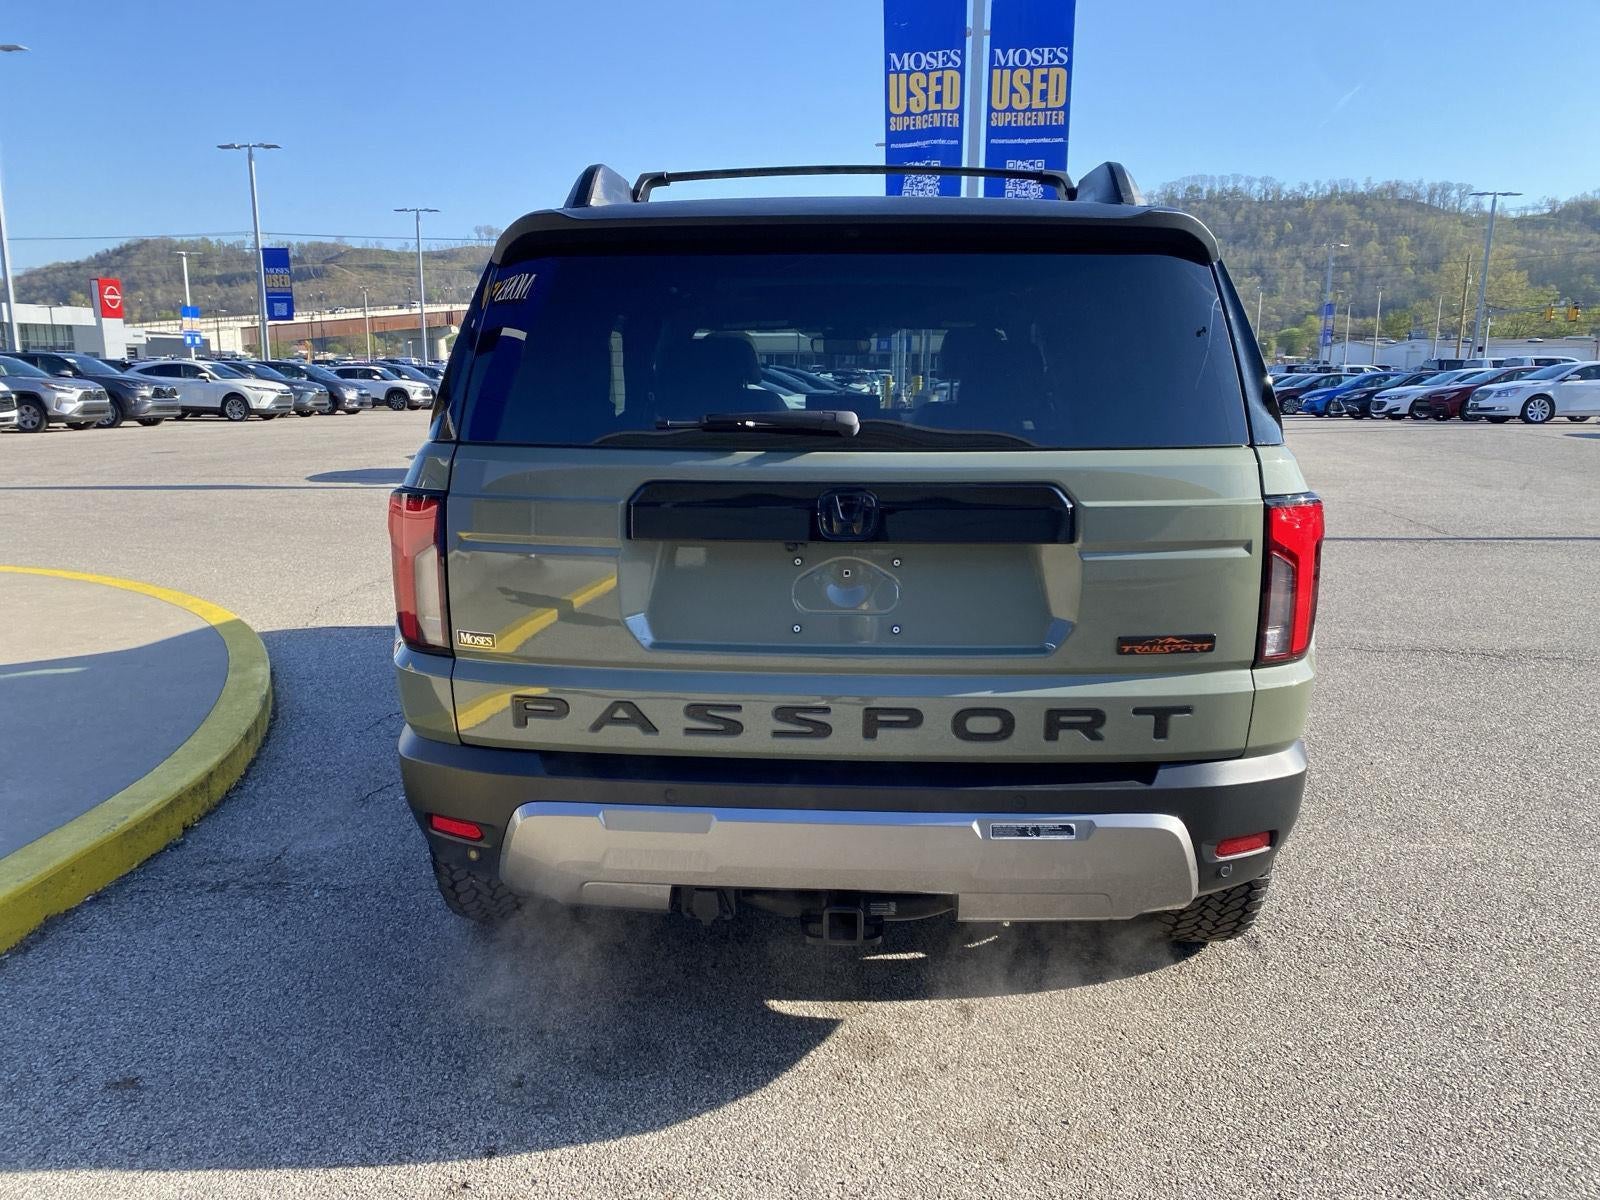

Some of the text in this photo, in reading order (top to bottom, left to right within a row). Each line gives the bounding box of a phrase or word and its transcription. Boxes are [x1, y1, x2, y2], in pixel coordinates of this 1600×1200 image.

[889, 49, 961, 71] MOSES
[994, 47, 1068, 67] MOSES
[888, 69, 961, 114] USED
[991, 67, 1068, 110] USED
[889, 112, 959, 131] SUPERCENTER
[990, 111, 1065, 127] SUPERCENTER
[266, 274, 291, 288] USED
[1121, 642, 1214, 654] TRAILSPORT
[512, 694, 1194, 743] PASSPORT
